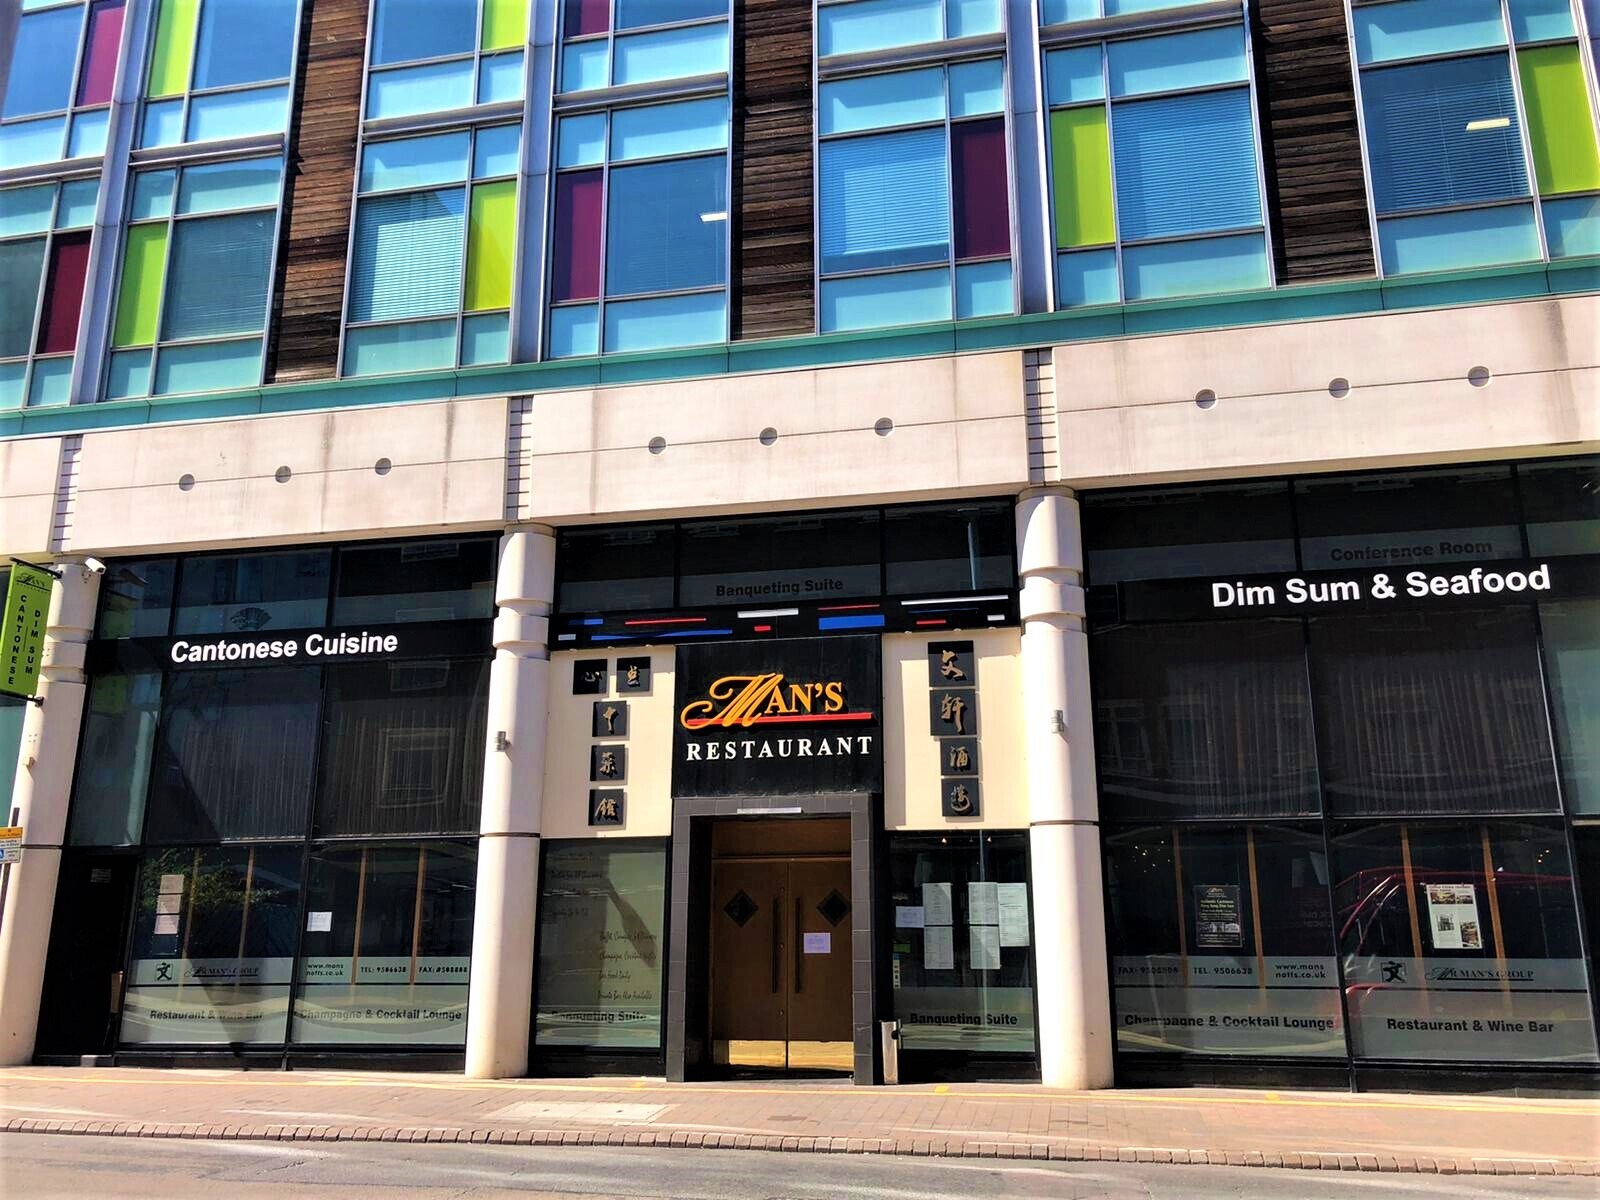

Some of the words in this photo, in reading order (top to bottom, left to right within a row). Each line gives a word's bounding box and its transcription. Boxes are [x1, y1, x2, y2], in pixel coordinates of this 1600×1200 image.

[1331, 543, 1438, 562] Conference
[1440, 540, 1493, 556] Room
[716, 581, 800, 598] Banqueting
[804, 578, 844, 592] Suite
[1211, 581, 1276, 608] Dim
[1285, 577, 1361, 604] Sum
[1370, 572, 1398, 600] &
[1405, 563, 1552, 598] Seafood
[31, 609, 42, 638] DIM
[8, 594, 28, 685] CANTONESE
[171, 639, 298, 663] Cantonese
[304, 631, 399, 656] Cuisine
[25, 646, 36, 675] SUM
[680, 673, 844, 730] MAN'S
[685, 736, 873, 761] RESTAURANT
[150, 1010, 205, 1020] Restaurant
[300, 1009, 362, 1022] Champagne
[365, 1009, 374, 1019] &
[376, 1009, 420, 1019] Cocktail
[423, 1009, 462, 1021] Lounge
[910, 1012, 982, 1026] Banqueting
[985, 1012, 1018, 1025] Suite
[1124, 1014, 1204, 1029] Champagne
[1208, 1015, 1218, 1027] &
[1222, 1015, 1279, 1028] Cocktail
[1283, 1016, 1335, 1031] Lounge
[1386, 1018, 1468, 1031] Restaurant
[1472, 1019, 1484, 1032] &
[1487, 1019, 1524, 1032] Wine
[1528, 1020, 1554, 1033] Bar
